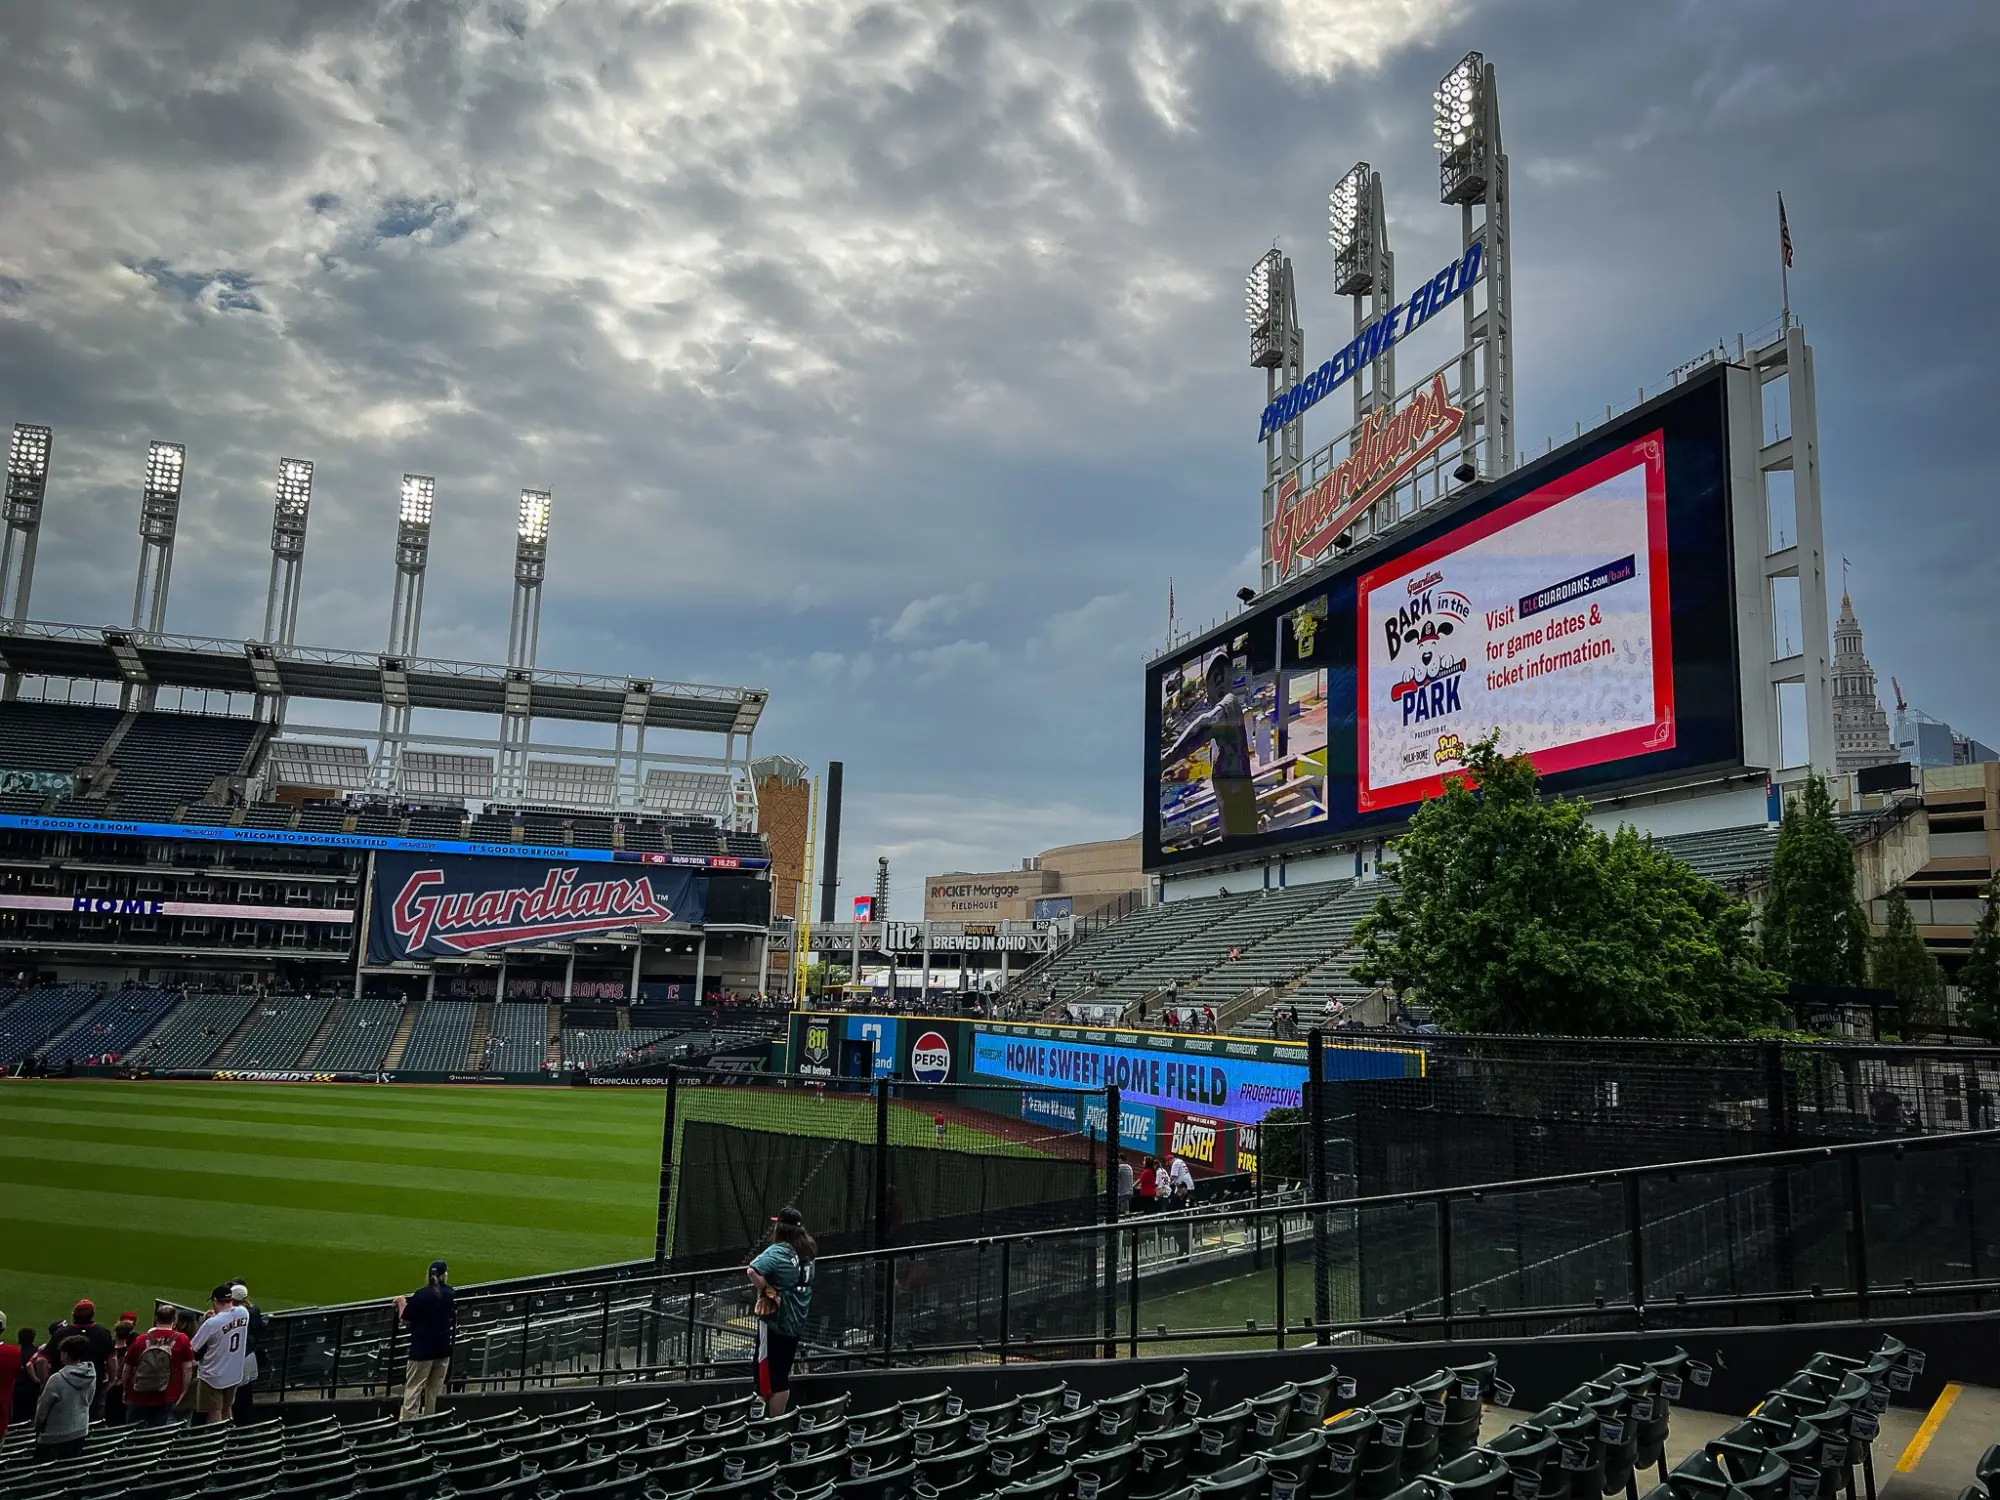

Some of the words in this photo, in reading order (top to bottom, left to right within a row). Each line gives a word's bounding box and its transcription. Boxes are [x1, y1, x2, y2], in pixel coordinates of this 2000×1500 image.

[1258, 304, 1401, 443] PROGRESSIVE
[1404, 242, 1483, 339] FIELD
[1270, 372, 1465, 578] Guardians
[1385, 590, 1433, 661] BARK
[1437, 596, 1448, 609] in
[1451, 598, 1469, 618] the
[1485, 605, 1515, 632] Visit
[1486, 641, 1504, 661] for
[1507, 628, 1543, 659] game
[1546, 613, 1586, 641] dates
[1589, 603, 1602, 626] &
[1486, 663, 1524, 691] ticket
[1526, 638, 1616, 679] information.
[1403, 675, 1461, 727] PARK
[20, 818, 39, 826] IT'S
[42, 820, 75, 829] GOOD
[76, 822, 90, 830] TO
[108, 824, 139, 832] HOME
[234, 831, 280, 840] WELCOME
[282, 833, 295, 841] TO
[297, 835, 361, 845] PROGRESSIVE
[363, 838, 388, 847] FIELD
[487, 846, 516, 855] GOOD
[517, 848, 529, 856] TO
[530, 848, 542, 856] BE
[543, 849, 570, 857] HOME
[931, 884, 973, 898] ROCKET
[973, 884, 1020, 899] Mortgage
[74, 897, 163, 915] HOME
[392, 867, 674, 953] Guardians
[880, 921, 919, 957] Lite
[963, 925, 995, 935] PROUDLY
[933, 936, 981, 950] BREWED
[983, 936, 996, 950] IN
[997, 936, 1026, 950] OHIO
[450, 979, 537, 996] CLEVEAND
[541, 981, 624, 999] GURDIANS
[808, 1028, 827, 1050] 811
[1148, 1036, 1174, 1048] PROGRESSIVE
[1184, 1039, 1215, 1051] PROGRESSIVE
[1226, 1042, 1259, 1055] PROGRESSIVE
[1273, 1046, 1309, 1060] PROGRESSIVE
[914, 1053, 948, 1067] PEPSI
[237, 1071, 314, 1082] CONRAD'S
[800, 1064, 811, 1074] Call
[812, 1064, 831, 1076] before
[1006, 1043, 1046, 1075] HOME
[1049, 1047, 1100, 1087] SWEET
[1103, 1055, 1160, 1095] HOME
[1166, 1062, 1228, 1107] FIELD
[589, 1077, 641, 1086] TECHNICALLY,
[1240, 1083, 1300, 1107] PROGRESSIVE
[1171, 1121, 1216, 1162] BLASTER
